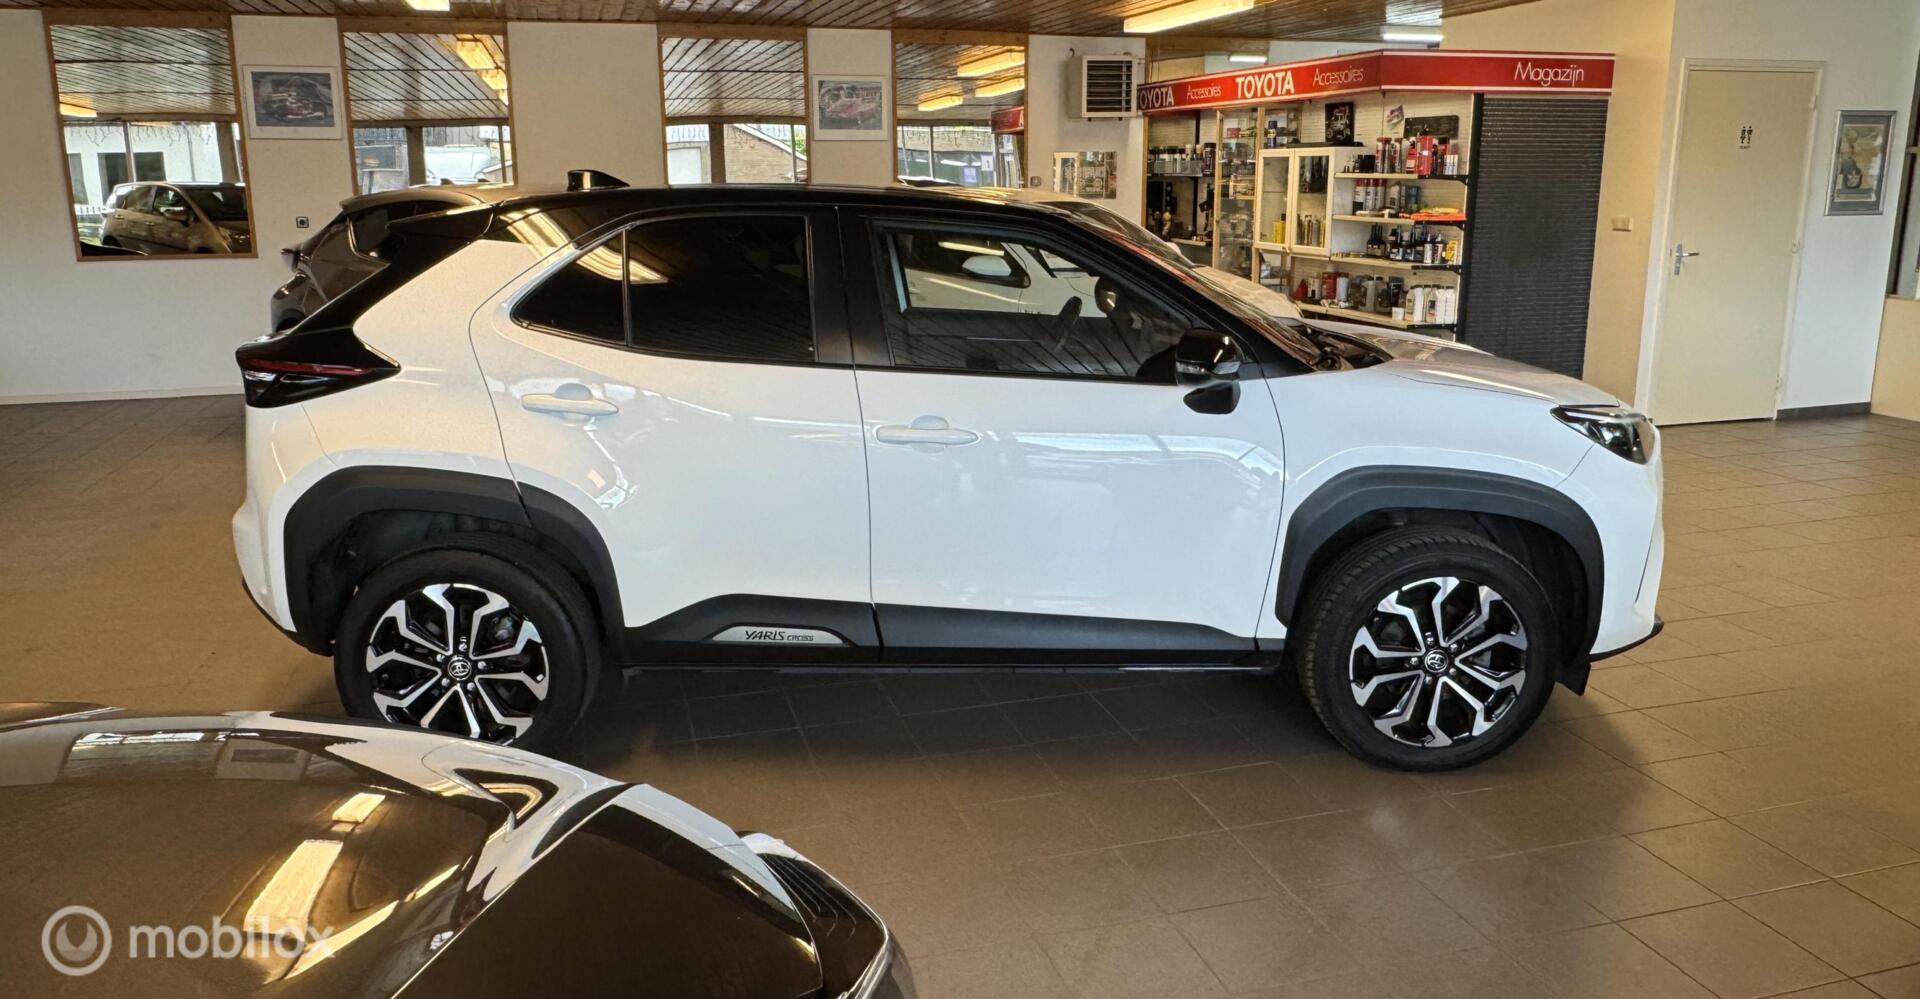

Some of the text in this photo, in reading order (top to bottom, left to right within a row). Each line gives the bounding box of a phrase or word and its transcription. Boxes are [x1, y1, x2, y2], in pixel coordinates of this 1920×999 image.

[1138, 86, 1174, 109] OYOTA
[1235, 71, 1294, 98] TOYOTA
[1312, 66, 1364, 87] Accessoires
[1514, 62, 1584, 87] Magazijn
